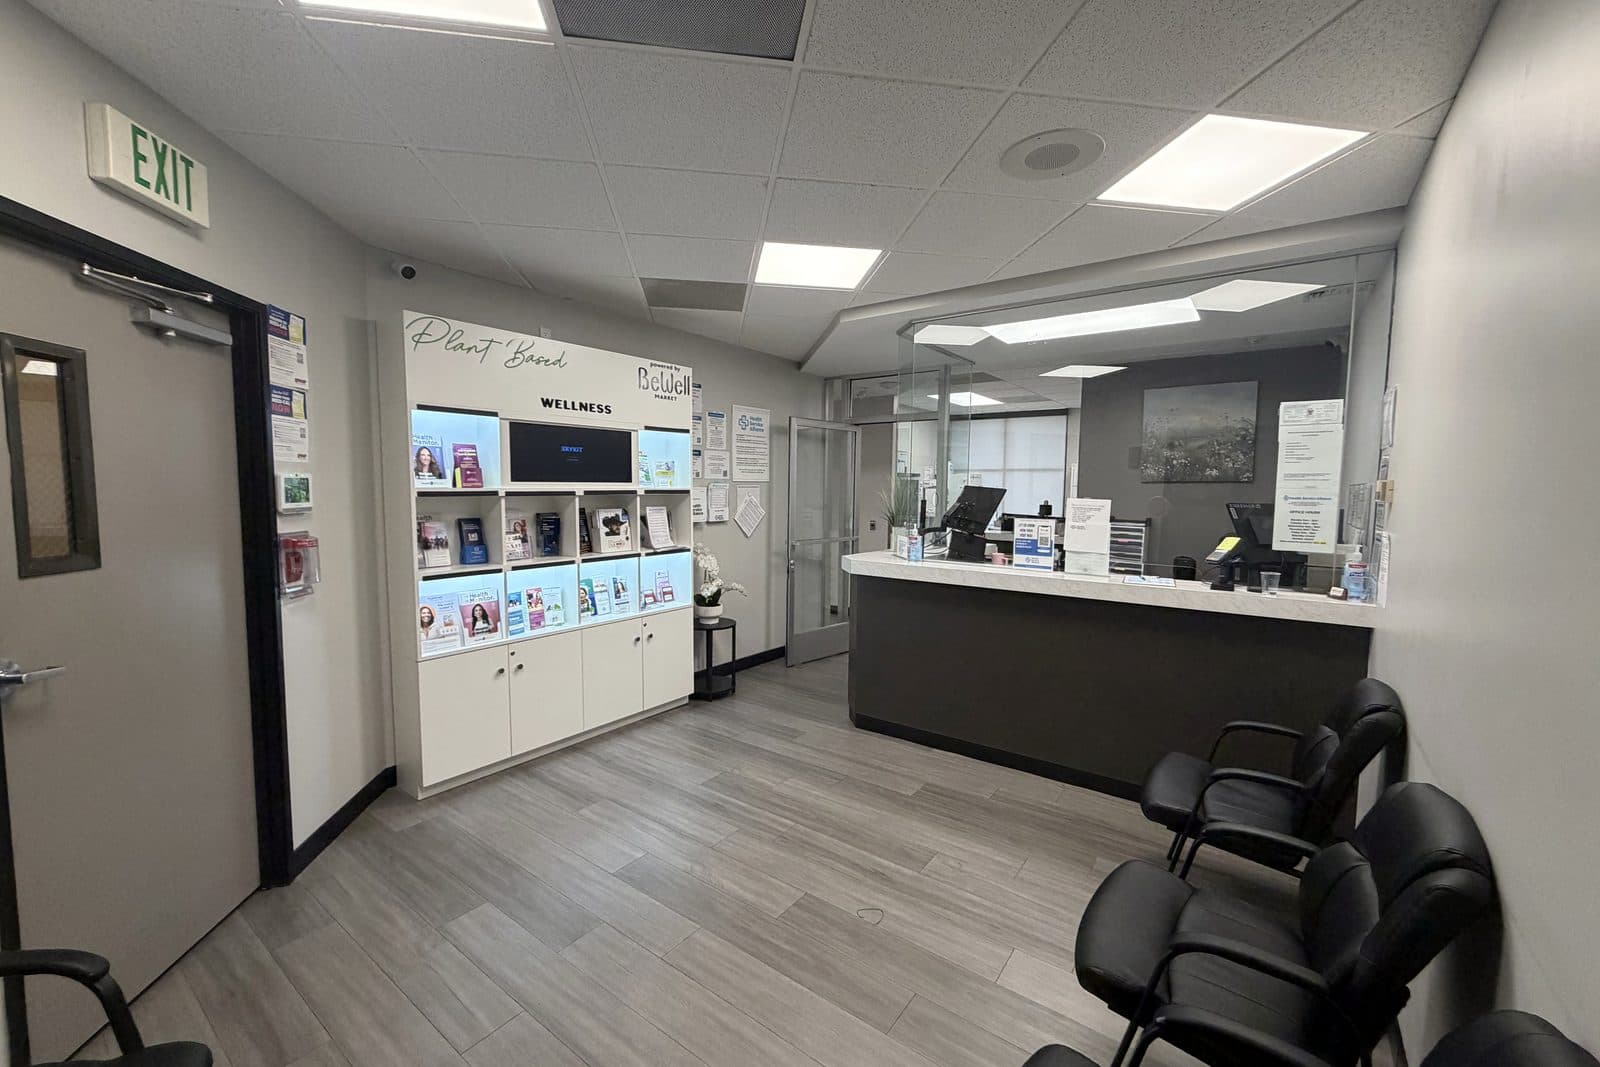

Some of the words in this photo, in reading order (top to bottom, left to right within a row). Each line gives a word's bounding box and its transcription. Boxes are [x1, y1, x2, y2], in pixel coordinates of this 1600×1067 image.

[131, 123, 194, 212] EXIT
[405, 316, 502, 364] Plant
[504, 337, 568, 368] Based
[638, 366, 690, 396] BeWell
[650, 362, 673, 370] powered
[540, 397, 612, 415] WELLNESS
